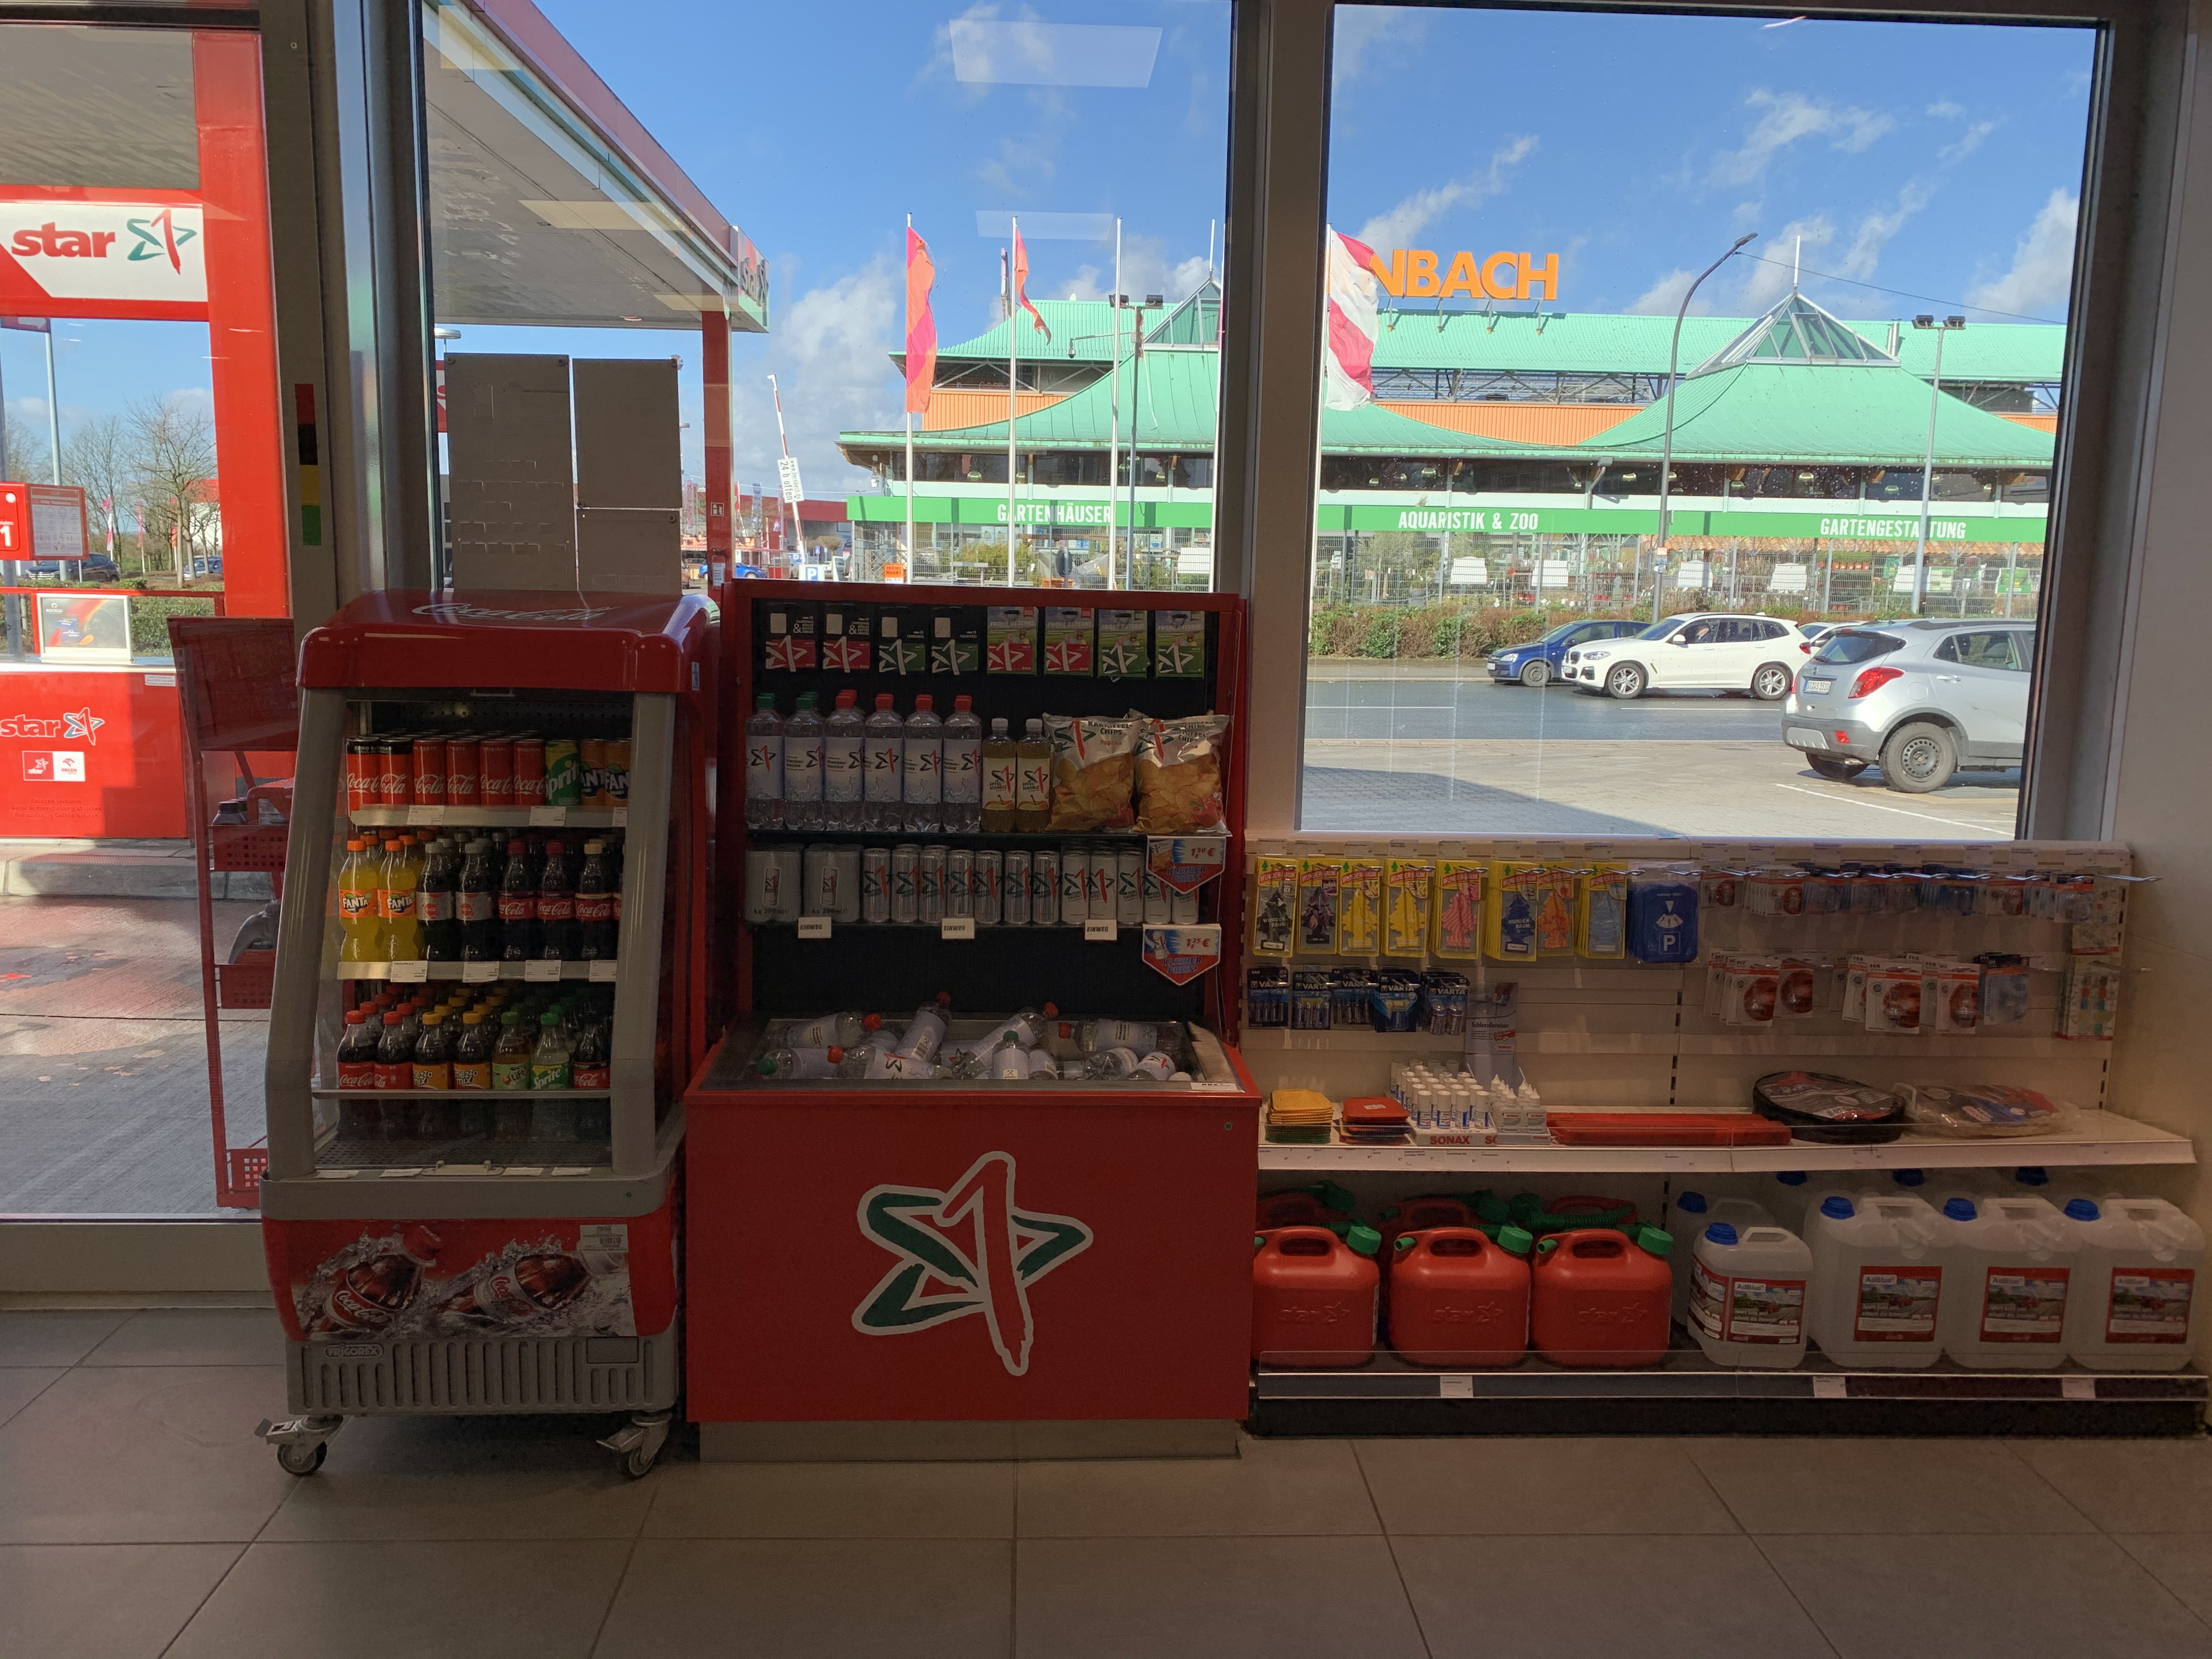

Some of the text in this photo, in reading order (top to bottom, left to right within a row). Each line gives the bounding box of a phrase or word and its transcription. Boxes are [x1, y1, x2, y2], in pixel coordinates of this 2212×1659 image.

[11, 221, 116, 258] star
[780, 461, 789, 471] 24
[790, 460, 802, 500] www.hornbach.de
[783, 480, 793, 501] offen
[996, 502, 1112, 524] GARTENHÄUSER
[1398, 511, 1539, 531] AQUARISTIK & ZOO
[806, 567, 817, 581] P
[411, 603, 623, 621] Coca-Cola
[793, 623, 802, 634] &
[849, 625, 857, 635] &
[0, 714, 60, 737] star
[605, 770, 630, 790] FAN
[1207, 848, 1215, 856] €
[1167, 866, 1206, 875] KLEINER
[1172, 873, 1202, 883] PREIS!
[342, 896, 369, 909] FANTA
[387, 896, 413, 910] FANTA
[537, 900, 572, 916] Coca-Cola
[1202, 938, 1210, 947] €
[1663, 934, 1676, 951] P
[1163, 956, 1202, 966] KLEINER
[1168, 965, 1198, 974] PREIS!
[340, 1072, 375, 1087] Coca-Cola
[454, 1069, 478, 1079] mezzo
[533, 1068, 561, 1090] Sprite
[414, 1077, 428, 1086] mix
[456, 1077, 473, 1086] mix
[1430, 1136, 1471, 1145] SONAX
[1278, 1305, 1319, 1321] star
[1432, 1306, 1474, 1322] star
[1577, 1307, 1619, 1323] star
